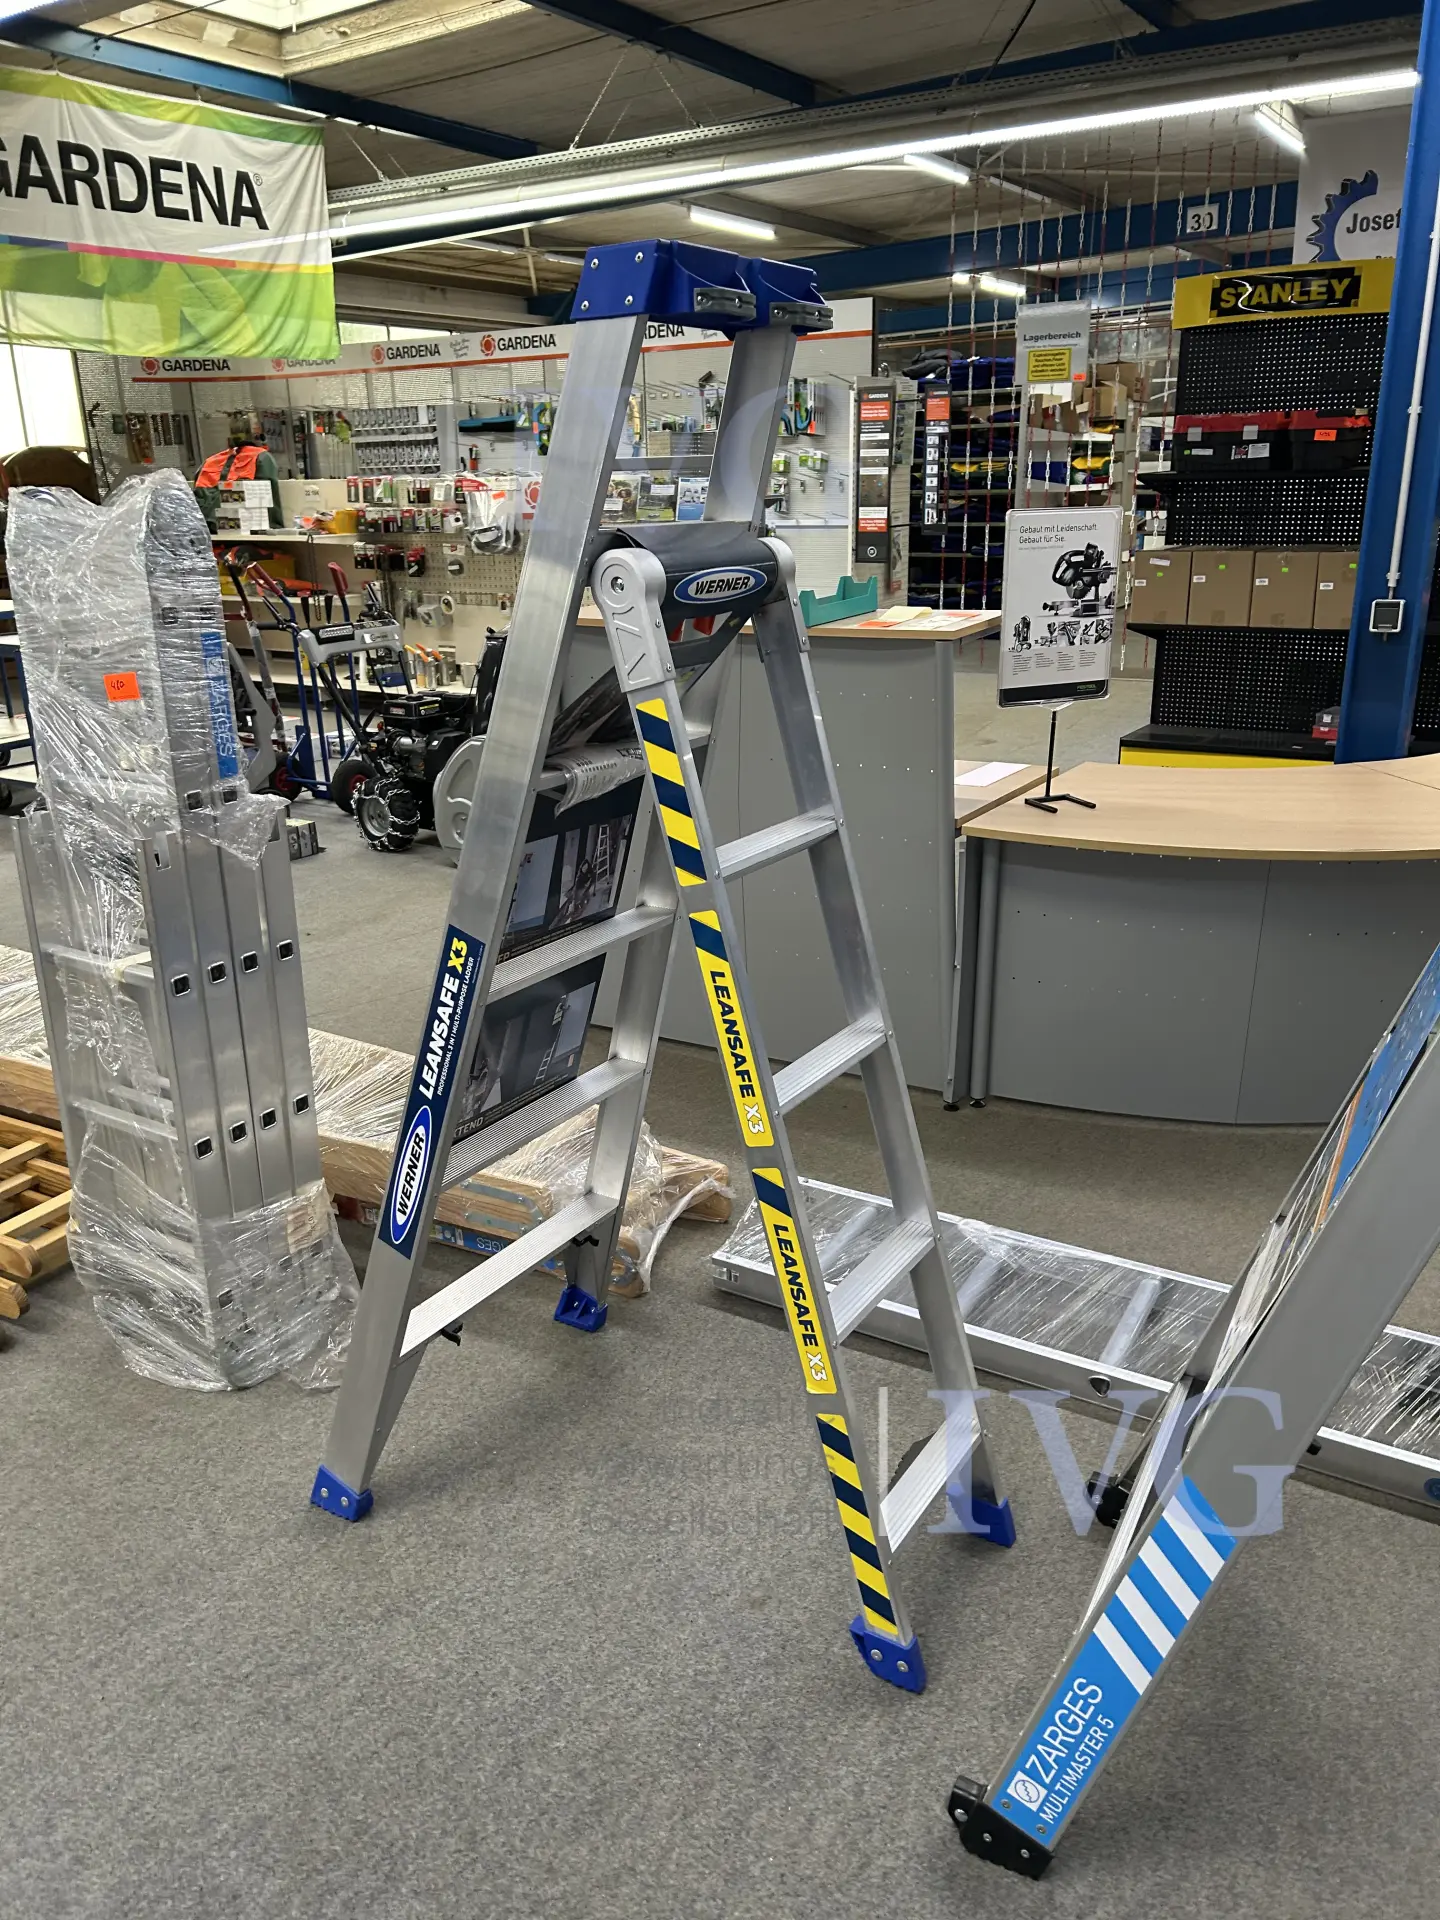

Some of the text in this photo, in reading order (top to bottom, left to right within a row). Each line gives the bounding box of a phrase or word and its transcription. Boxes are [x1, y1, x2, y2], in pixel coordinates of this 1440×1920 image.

[1191, 211, 1214, 231] 30
[1219, 277, 1352, 309] STANLEY
[643, 324, 685, 340] DENA
[1023, 331, 1082, 343] Lagerbereich
[386, 343, 441, 361] GARDENA
[497, 334, 557, 351] GARDENA
[162, 359, 231, 372] GARDENA
[1019, 525, 1043, 534] Gebaut
[1019, 535, 1043, 544] Gebaut
[1044, 535, 1053, 543] für
[694, 576, 751, 596] WERNER
[418, 936, 468, 1100] LEANSAFE X3
[436, 1050, 453, 1096] PROFESSIONAL
[451, 983, 469, 1034] MULTI-PURPOSE
[463, 956, 475, 984] LADDER
[709, 970, 765, 1134] LEANSAFE X3
[396, 1132, 425, 1217] WERNER
[773, 1223, 828, 1381] LEANSAFE X3
[1025, 1676, 1103, 1784] ZARGES
[1038, 1713, 1115, 1824] MULTIMASTER 5
